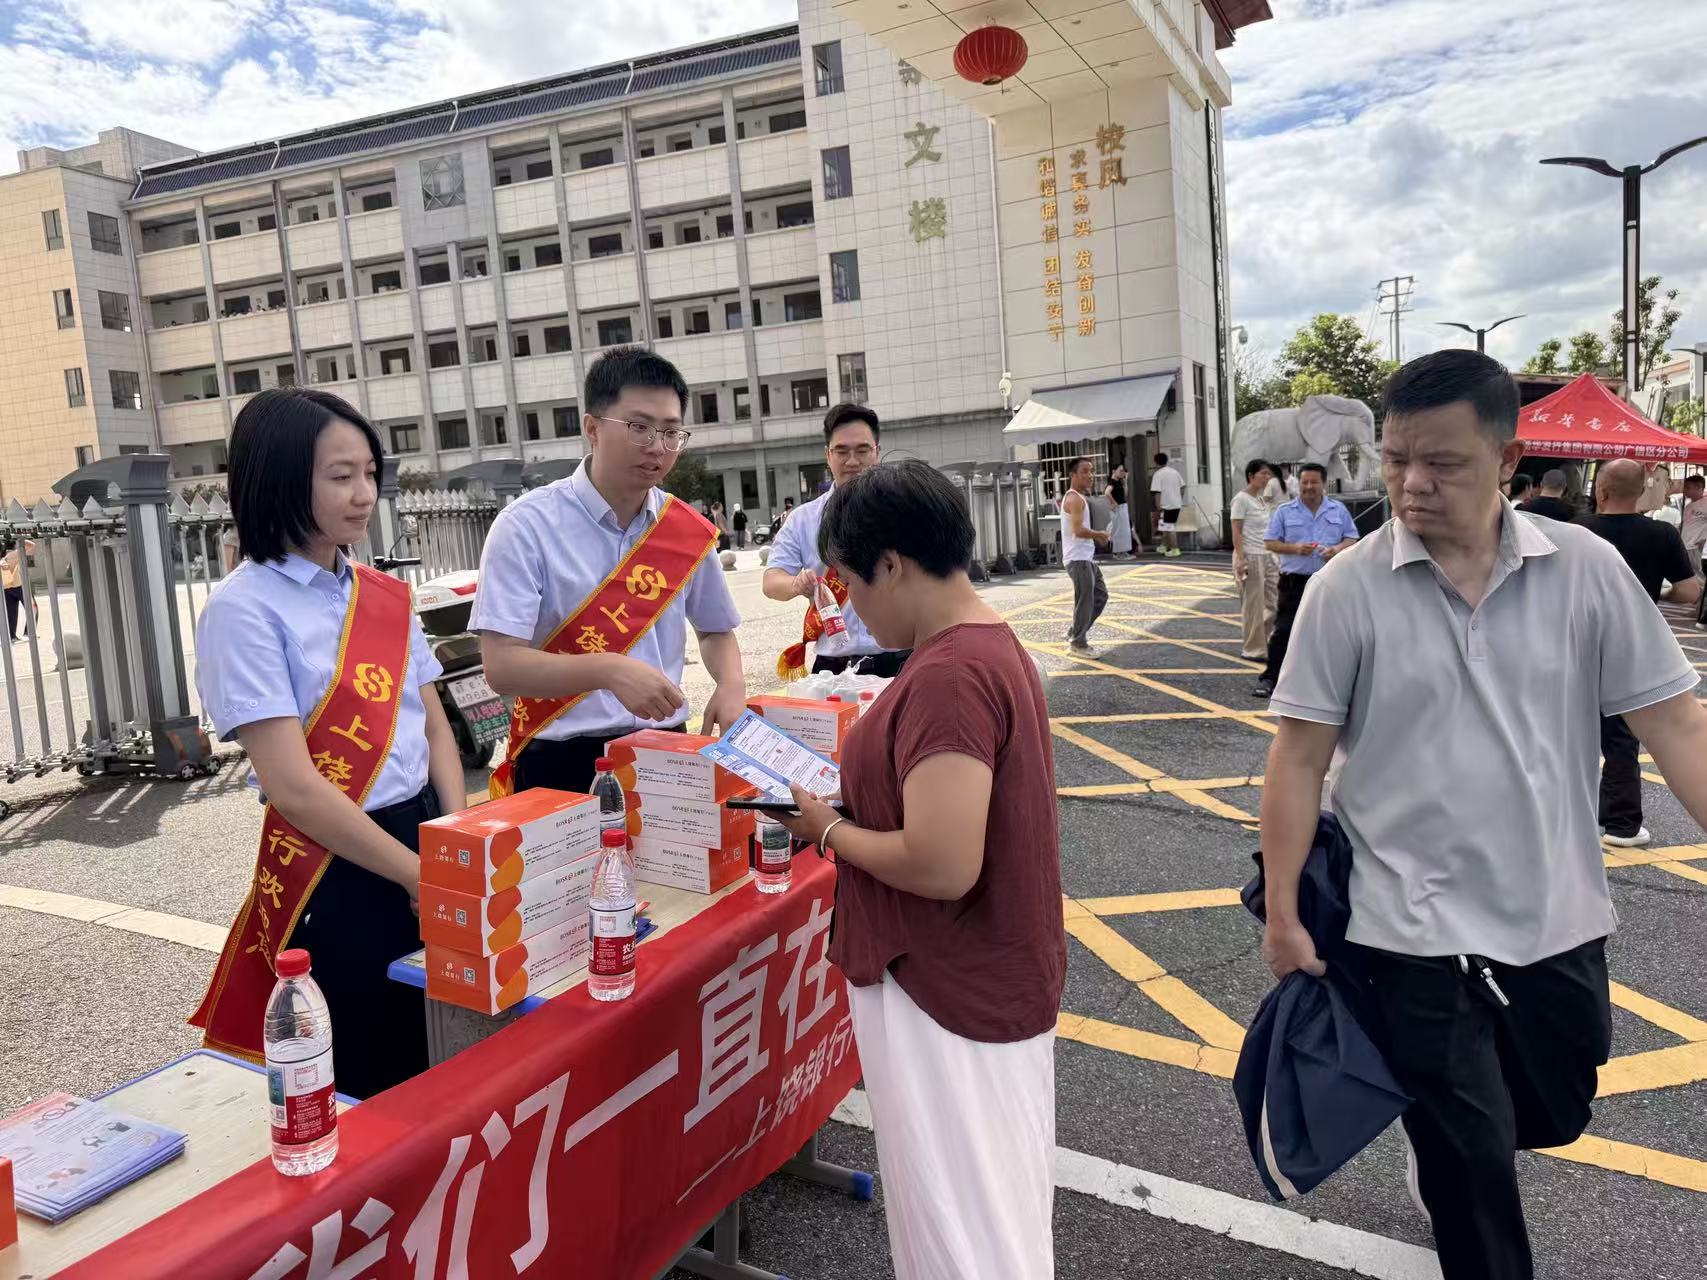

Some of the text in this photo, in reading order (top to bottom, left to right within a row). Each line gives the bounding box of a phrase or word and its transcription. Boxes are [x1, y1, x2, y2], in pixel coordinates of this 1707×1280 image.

[1038, 156, 1059, 244] 和谐诚信
[1096, 122, 1128, 191] 校风
[1070, 148, 1097, 337] 求真务实 发奋创新
